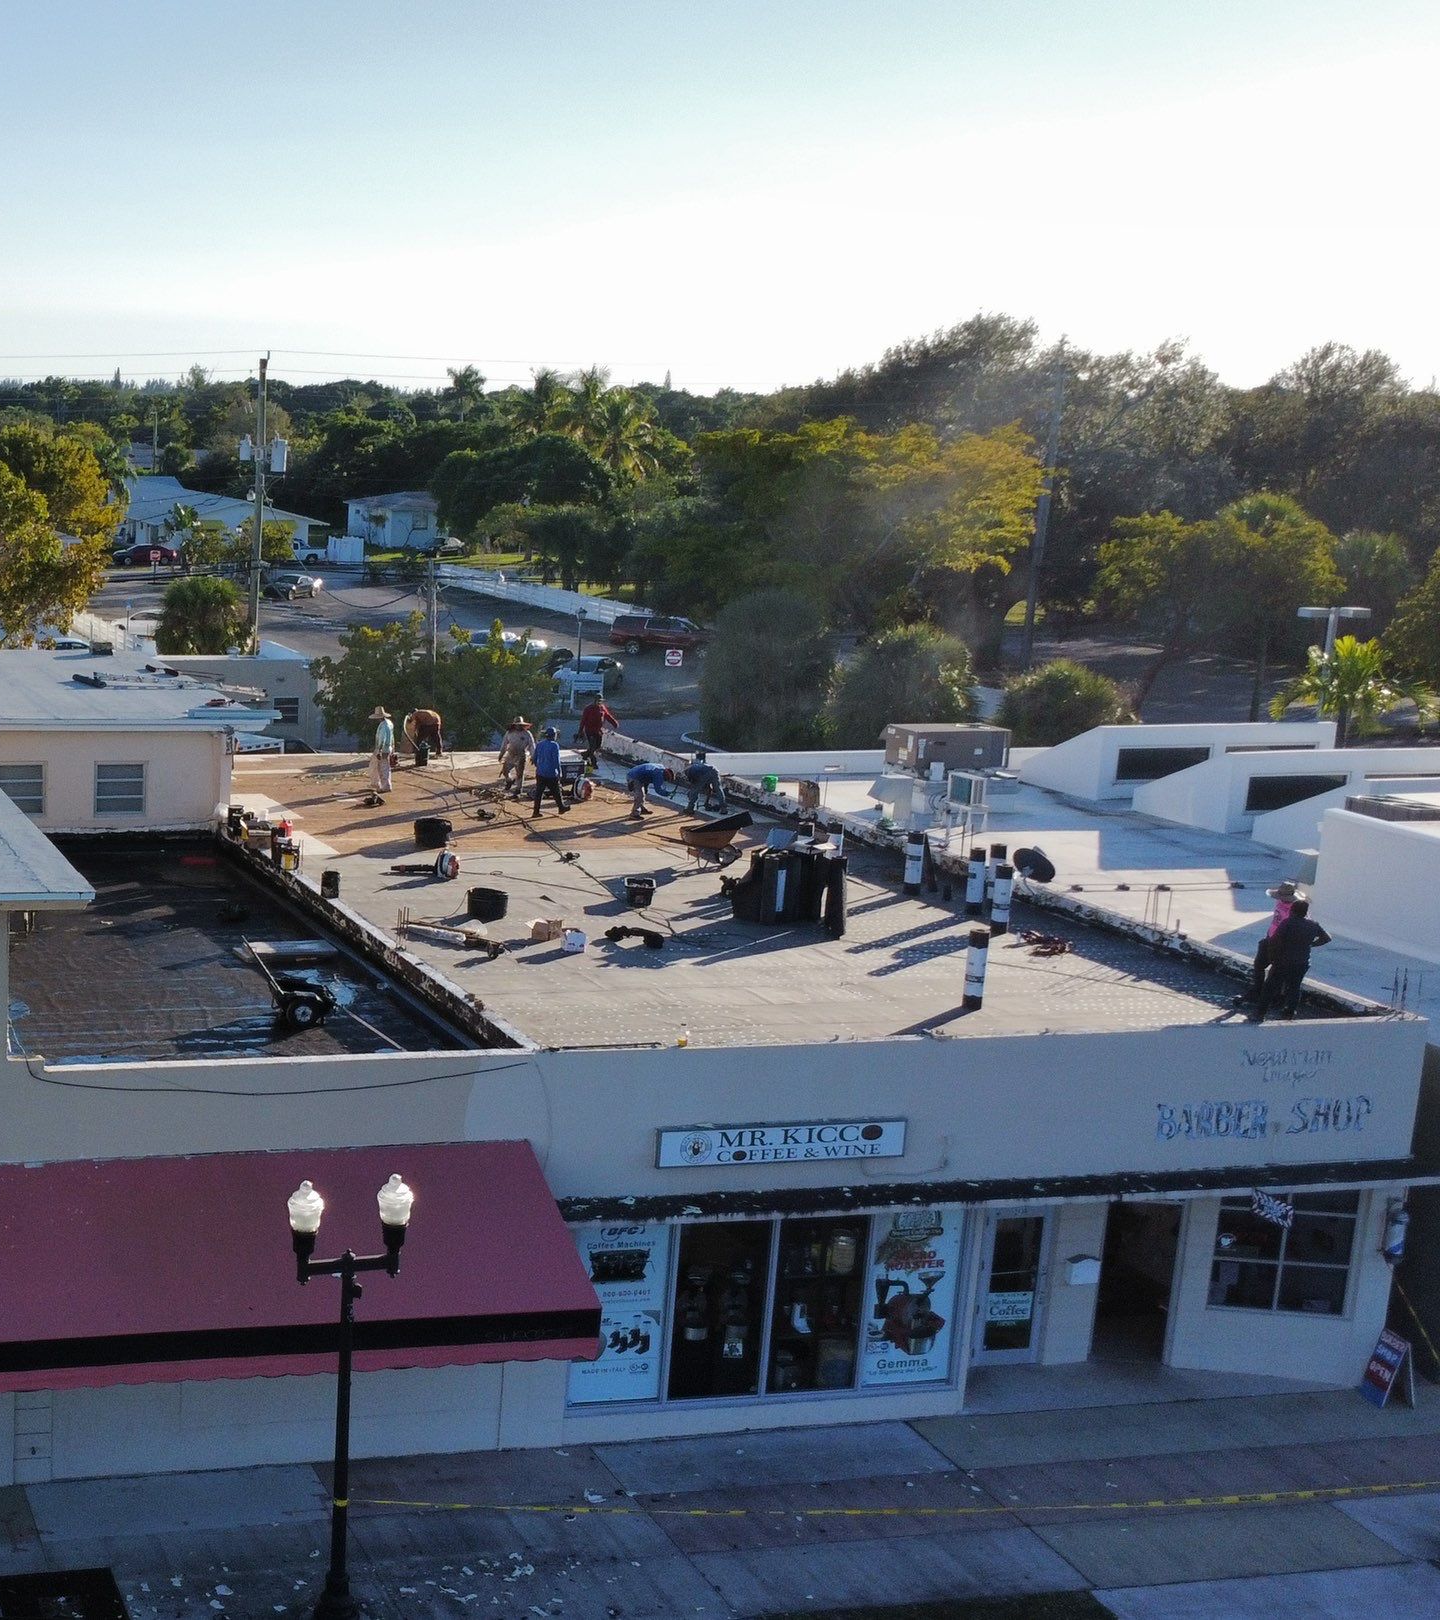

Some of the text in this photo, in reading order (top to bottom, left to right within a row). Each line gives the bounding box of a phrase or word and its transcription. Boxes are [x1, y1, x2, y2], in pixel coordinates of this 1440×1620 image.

[1156, 1095, 1373, 1141] BARBER SHOP
[718, 1130, 774, 1148] MR.
[782, 1124, 883, 1145] KICCO
[716, 1147, 797, 1163] COFFEE
[803, 1147, 820, 1158] &
[824, 1143, 881, 1157] WINE
[586, 1240, 656, 1250] Coffee Machines
[989, 1304, 1028, 1316] Coffee
[876, 1359, 928, 1369] Gemma
